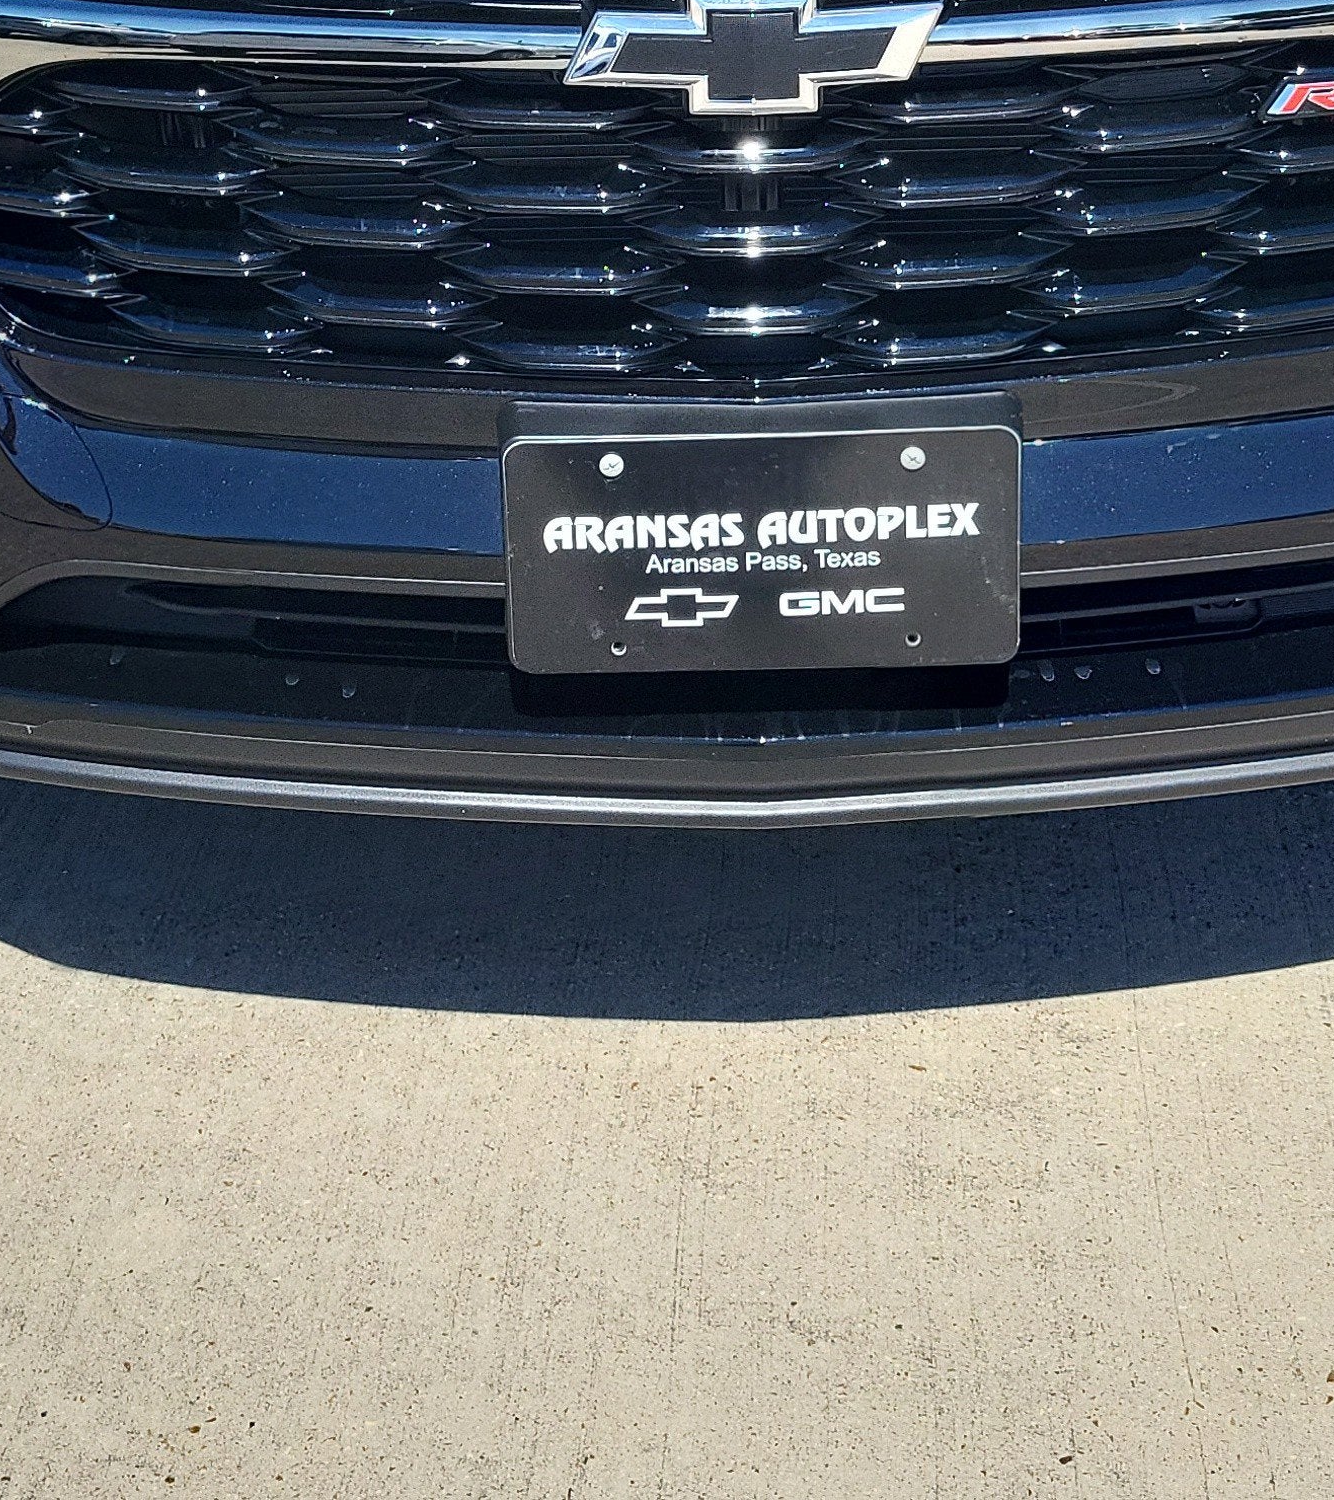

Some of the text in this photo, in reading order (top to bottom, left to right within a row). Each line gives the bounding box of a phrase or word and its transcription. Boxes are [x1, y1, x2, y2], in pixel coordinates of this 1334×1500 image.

[542, 502, 980, 554] ARANSAS AUTOPLEX
[645, 547, 882, 575] Aransas Pass, Texas
[778, 587, 906, 618] GMC
